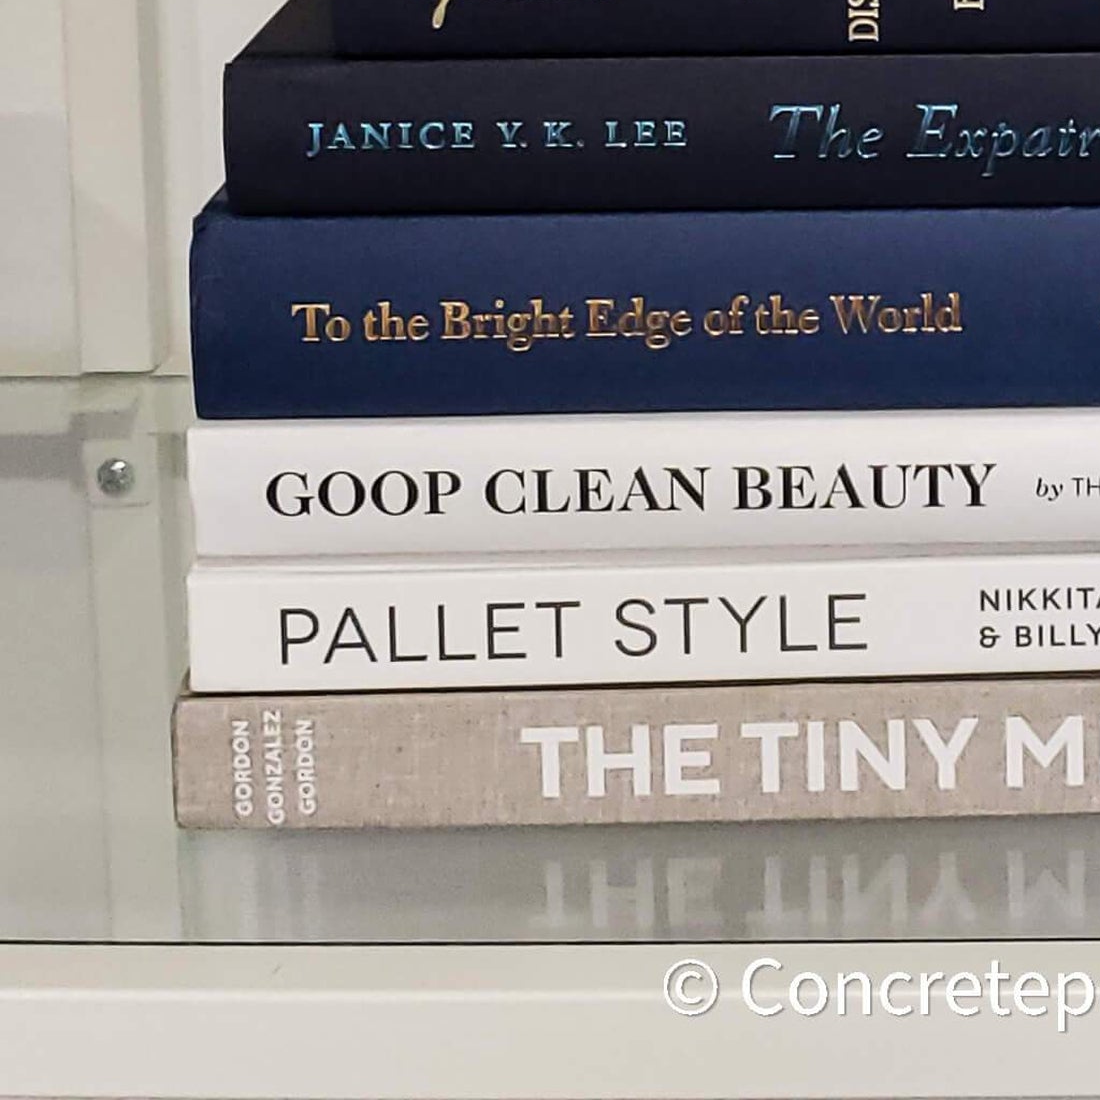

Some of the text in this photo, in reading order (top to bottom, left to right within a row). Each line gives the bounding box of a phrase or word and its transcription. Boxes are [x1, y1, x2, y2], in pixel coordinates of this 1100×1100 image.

[307, 120, 687, 157] JANICE Y. K. LEE
[769, 103, 883, 159] The
[291, 292, 963, 352] To the Bright Edge of the World
[265, 463, 996, 517] GOOP CLEAN BEAUTY
[1035, 477, 1064, 502] by
[280, 593, 868, 665] PALLET STYLE
[979, 626, 1000, 649] &
[231, 720, 253, 817] GORDON
[263, 709, 285, 825] GONZALEZ
[296, 719, 317, 816] GORDON
[520, 724, 721, 799] THE
[740, 717, 979, 794] TINY
